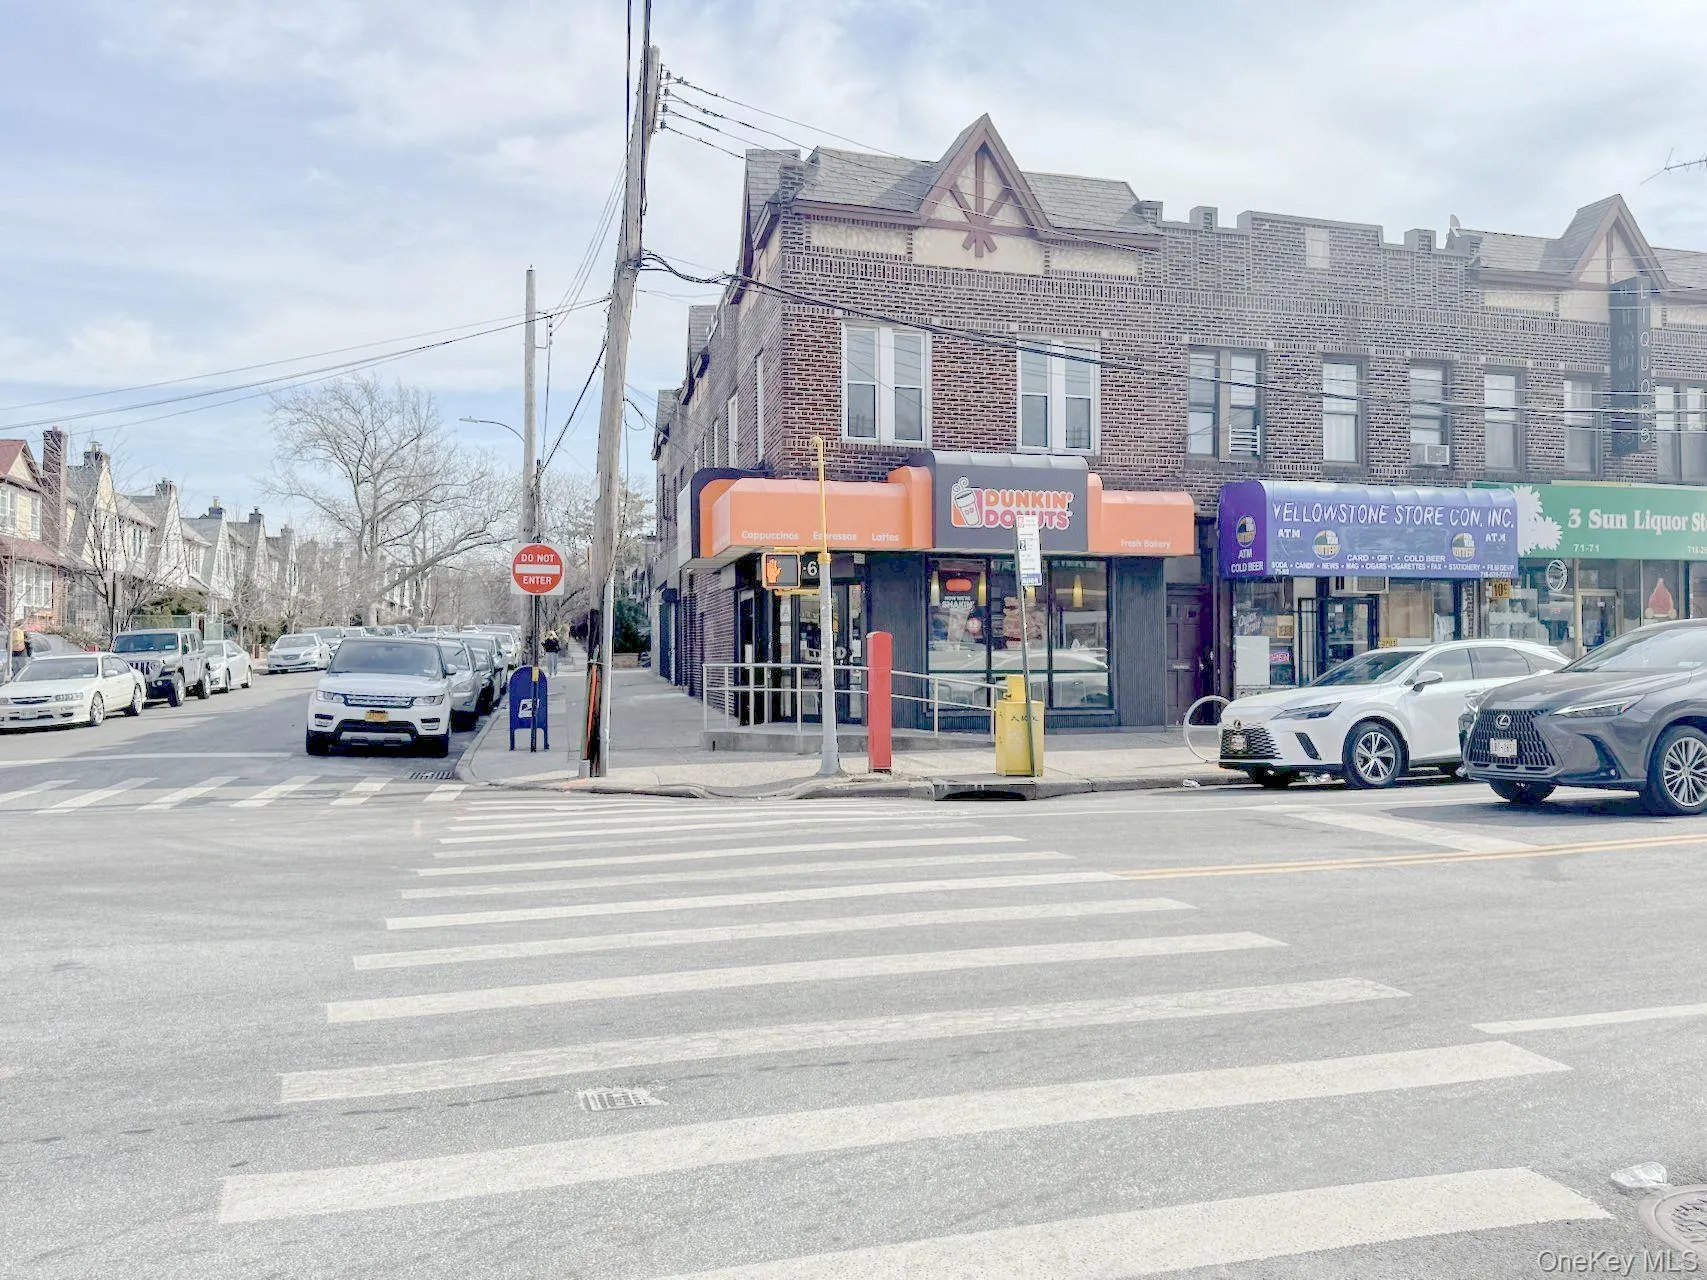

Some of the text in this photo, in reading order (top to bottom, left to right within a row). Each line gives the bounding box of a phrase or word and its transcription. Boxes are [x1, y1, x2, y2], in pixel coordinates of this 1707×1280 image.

[984, 490, 1074, 509] DUNKIN'
[1272, 502, 1390, 525] YELLOWSTONE
[1395, 505, 1444, 526] STORE
[1449, 508, 1483, 527] CON.
[1487, 508, 1515, 528] INC.
[1567, 508, 1581, 529] 3
[1588, 508, 1628, 529] Sun
[1634, 509, 1689, 536] Liquor
[741, 530, 799, 541] Cappuccinos
[871, 532, 900, 542] Lattes
[1278, 529, 1301, 538] ATM
[1121, 539, 1171, 550] Fresh Bakery
[1573, 543, 1600, 552] 71-71
[521, 553, 555, 563] DO NOT
[1238, 548, 1253, 559] ATM
[1346, 554, 1446, 563] CARD GIFT COLD BEER
[1231, 561, 1264, 573] COLD BEER
[1271, 561, 1288, 569] SODA
[1321, 562, 1340, 570] NEWS
[1430, 563, 1442, 571] FAX
[522, 576, 552, 585] ENTER
